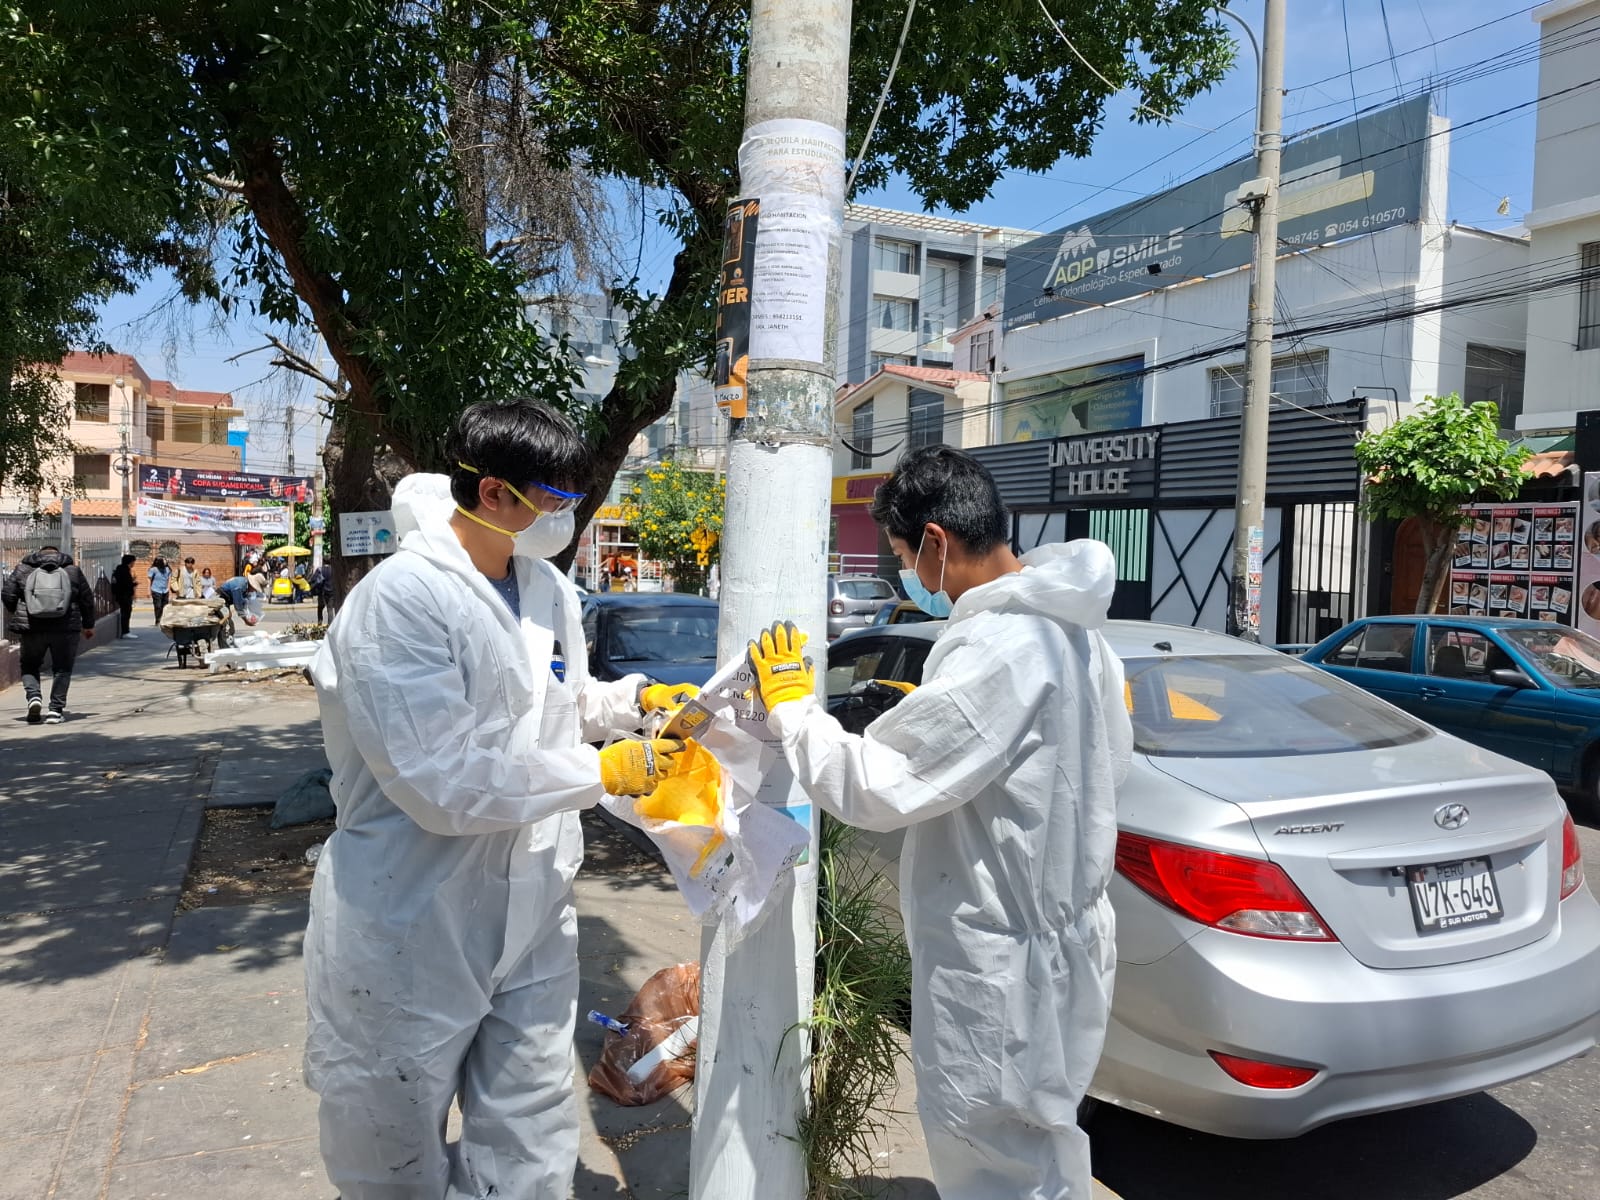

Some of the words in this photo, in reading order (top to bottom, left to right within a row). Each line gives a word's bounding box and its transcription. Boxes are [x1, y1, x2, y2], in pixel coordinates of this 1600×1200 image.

[1339, 218, 1359, 234] 054
[1361, 206, 1405, 228] 610570
[1112, 226, 1184, 268] SMILE
[1049, 431, 1160, 468] UNIVERSITY
[150, 469, 158, 480] 2
[212, 481, 265, 491] SUDAMERICANA
[1068, 467, 1130, 496] HOUSE
[1273, 822, 1345, 836] ACCENT
[1416, 873, 1494, 918] V7K-646
[1462, 912, 1488, 922] MOTORS
